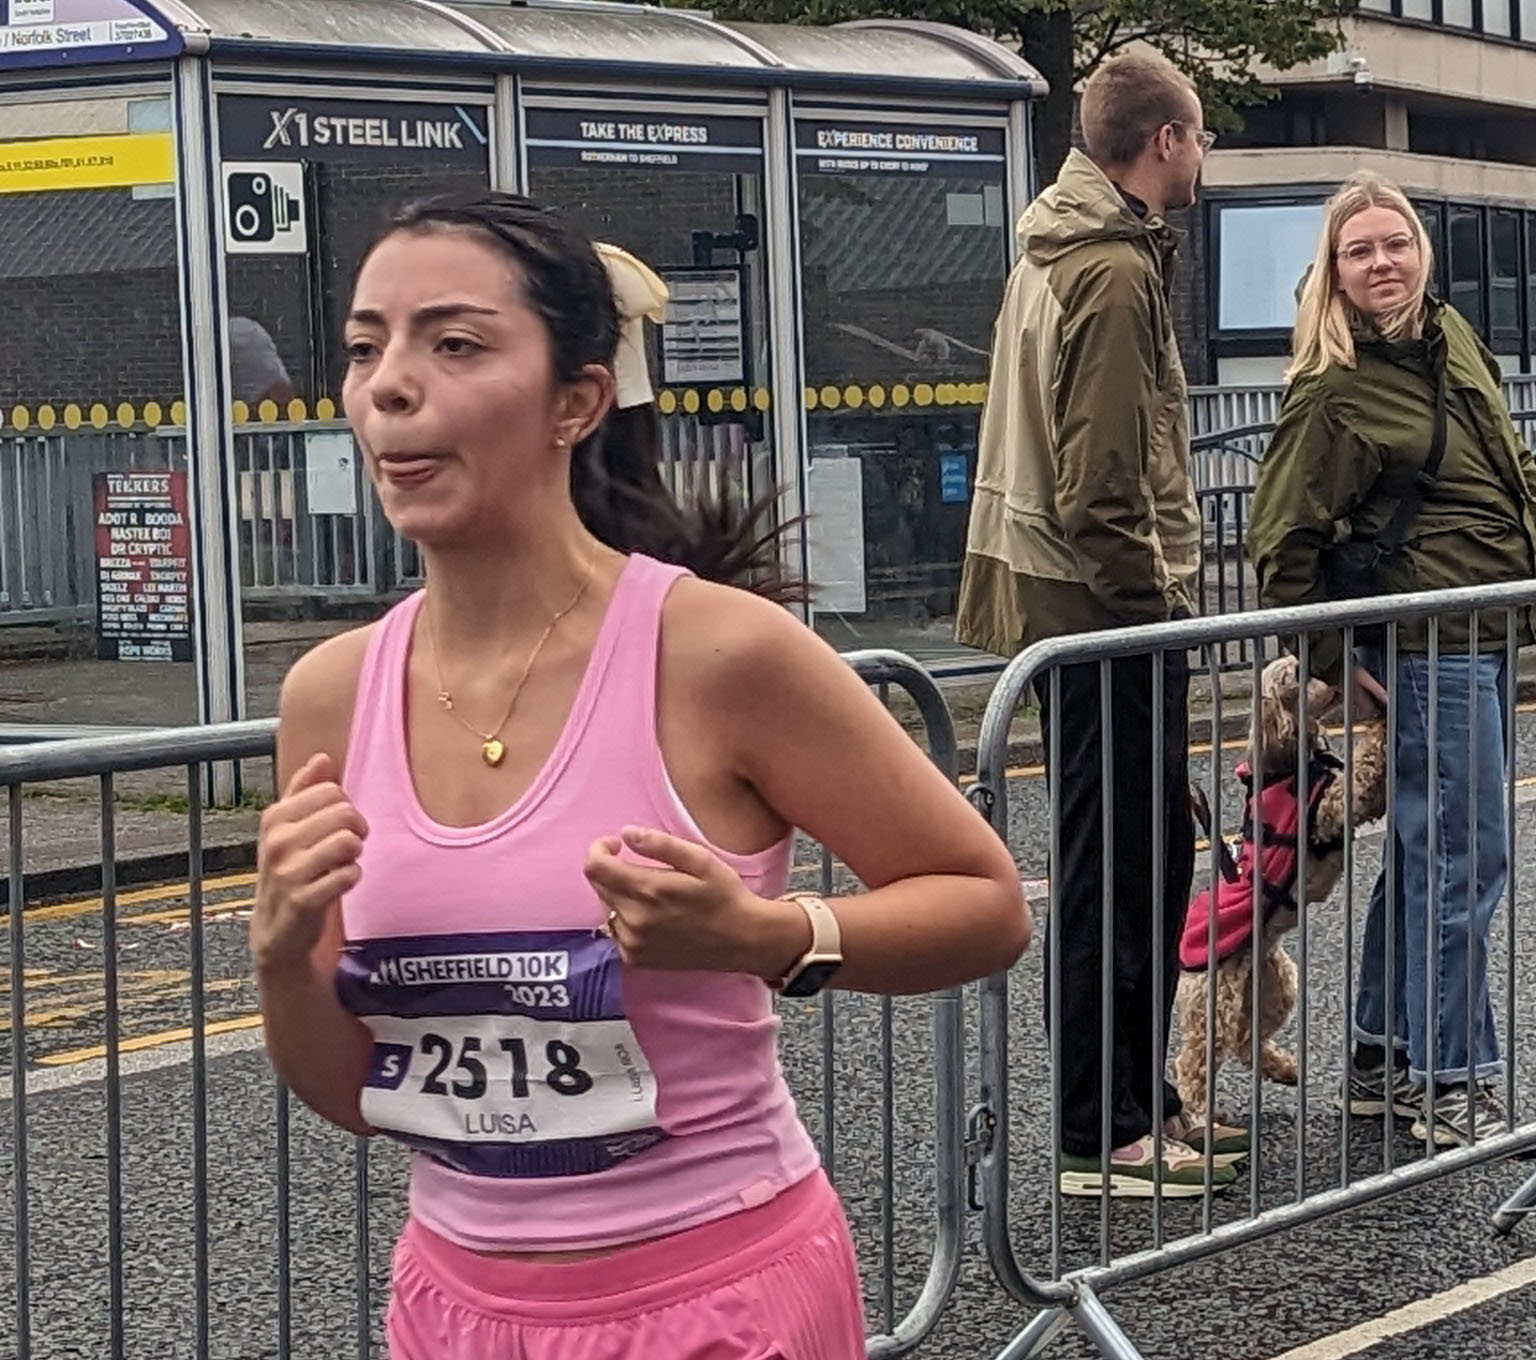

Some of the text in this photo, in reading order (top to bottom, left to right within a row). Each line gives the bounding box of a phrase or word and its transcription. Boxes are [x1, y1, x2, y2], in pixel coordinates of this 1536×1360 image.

[12, 31, 53, 47] Norfolk
[56, 27, 92, 43] Street
[263, 107, 463, 149] X1 STEEL LINK
[580, 122, 708, 143] TAKE THE EXPRESS
[817, 129, 979, 152] EXPERIENCE CONVENIENCE
[404, 955, 563, 982] SHEFFIELD 10K
[504, 984, 570, 1007] 2023
[381, 1055, 399, 1078] S
[418, 1033, 593, 1100] 2518
[465, 1113, 538, 1135] LUISA
